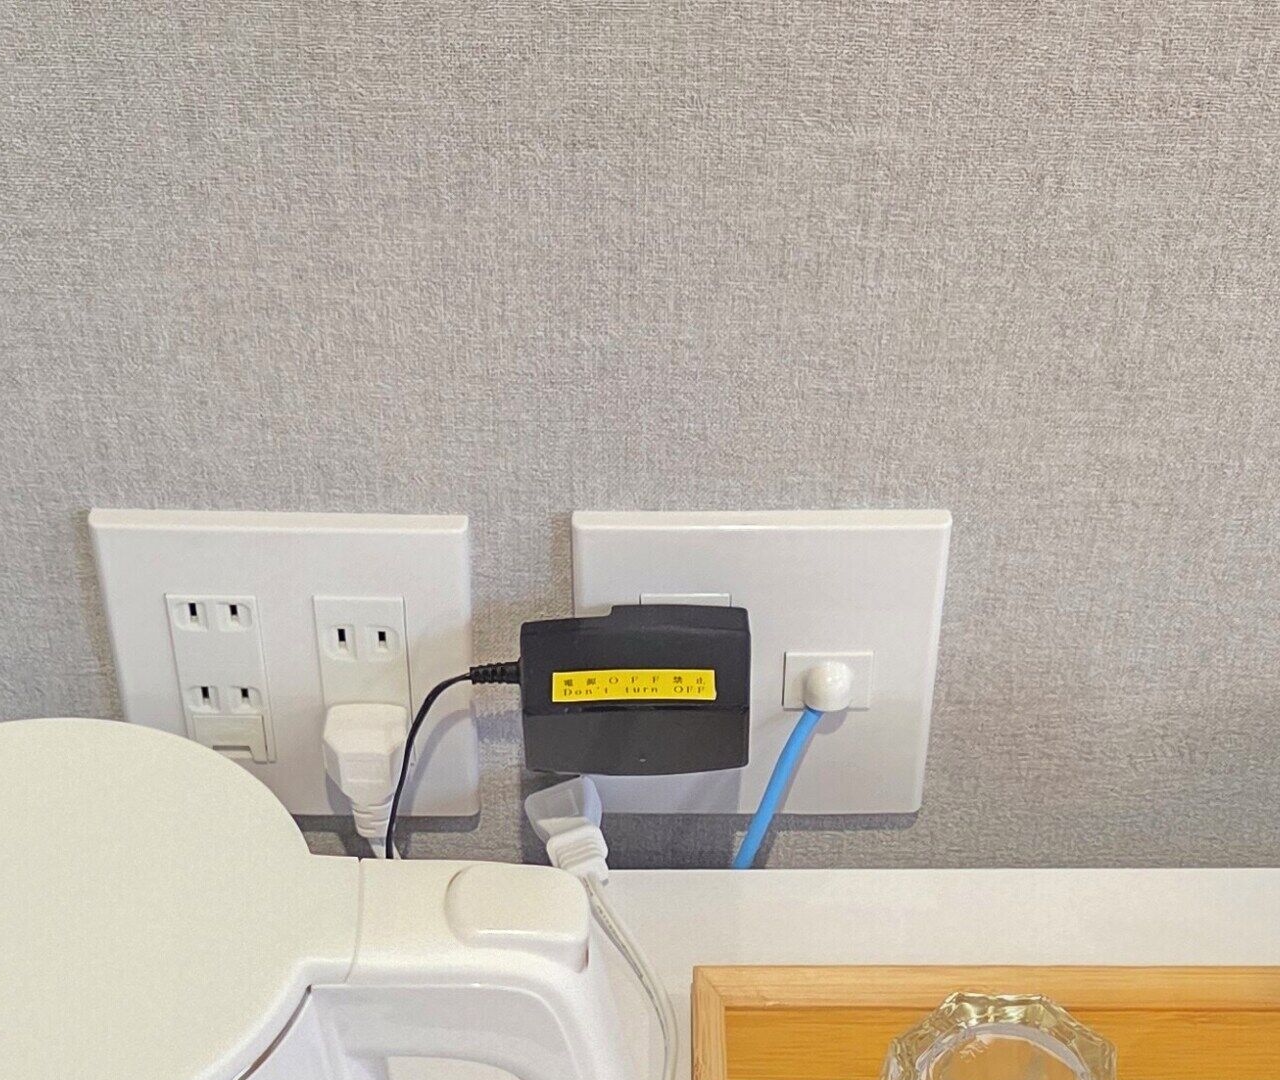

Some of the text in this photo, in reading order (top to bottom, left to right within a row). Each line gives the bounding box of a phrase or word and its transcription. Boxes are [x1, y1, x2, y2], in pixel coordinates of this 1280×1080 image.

[563, 685, 705, 697] Don't turn OFF
